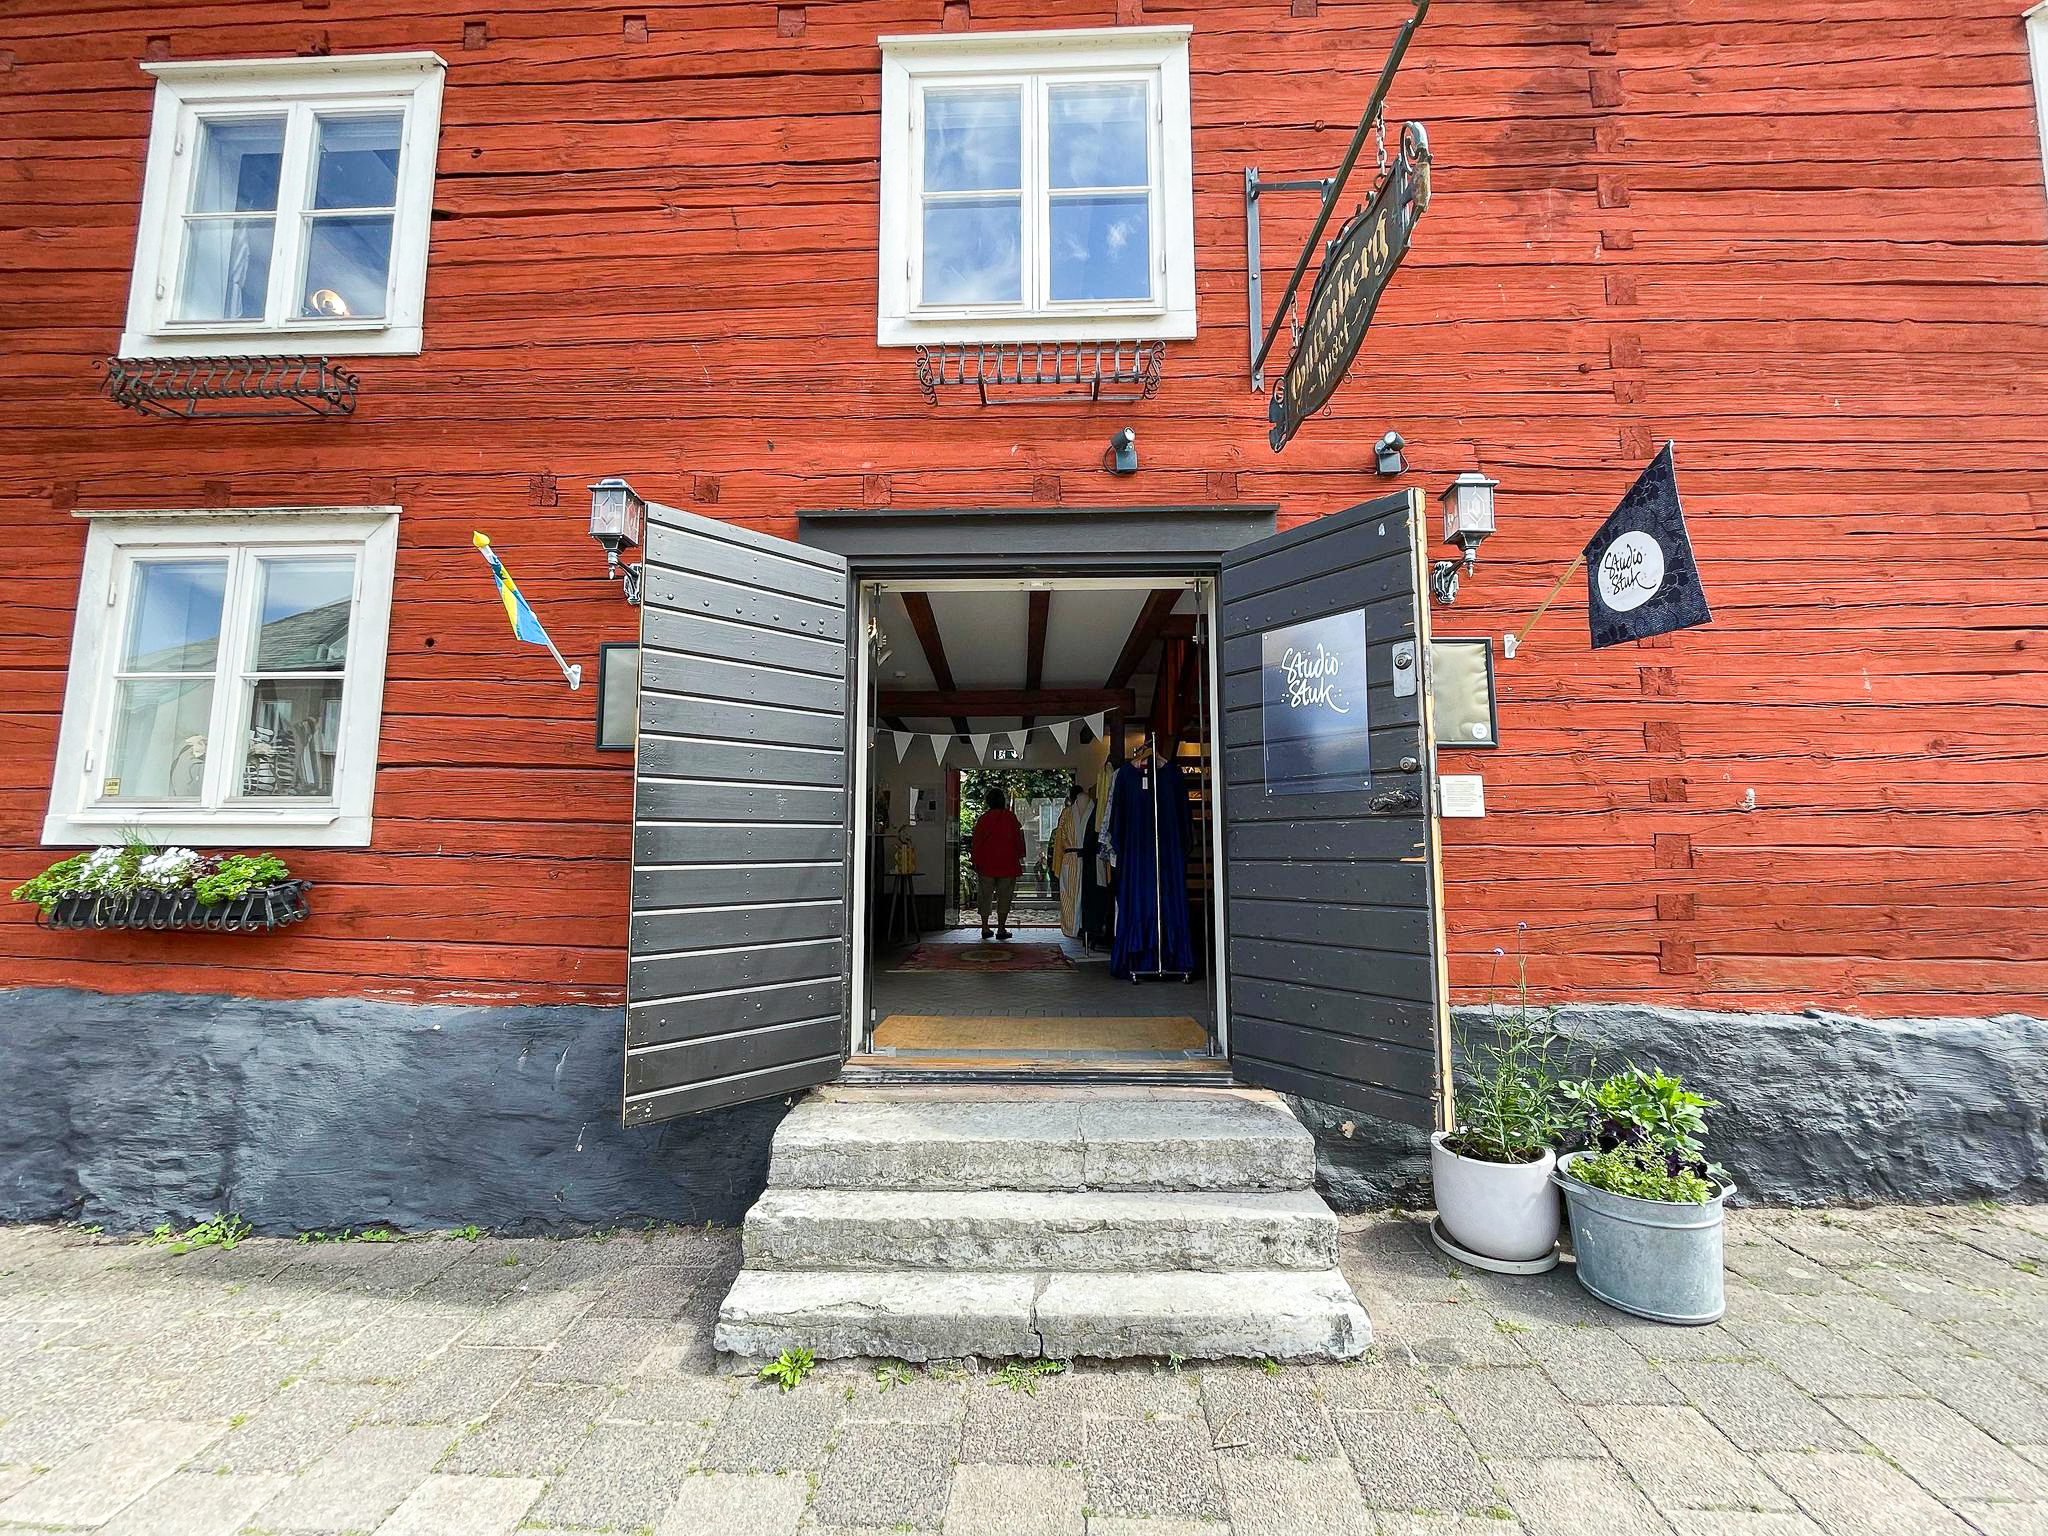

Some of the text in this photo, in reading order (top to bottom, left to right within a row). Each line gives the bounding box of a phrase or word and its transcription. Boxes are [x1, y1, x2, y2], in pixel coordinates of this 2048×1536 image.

[1604, 543, 1643, 580] Studio
[1612, 567, 1657, 595] Stuk
[1281, 643, 1339, 685] Studio
[1289, 677, 1350, 713] Stuk
